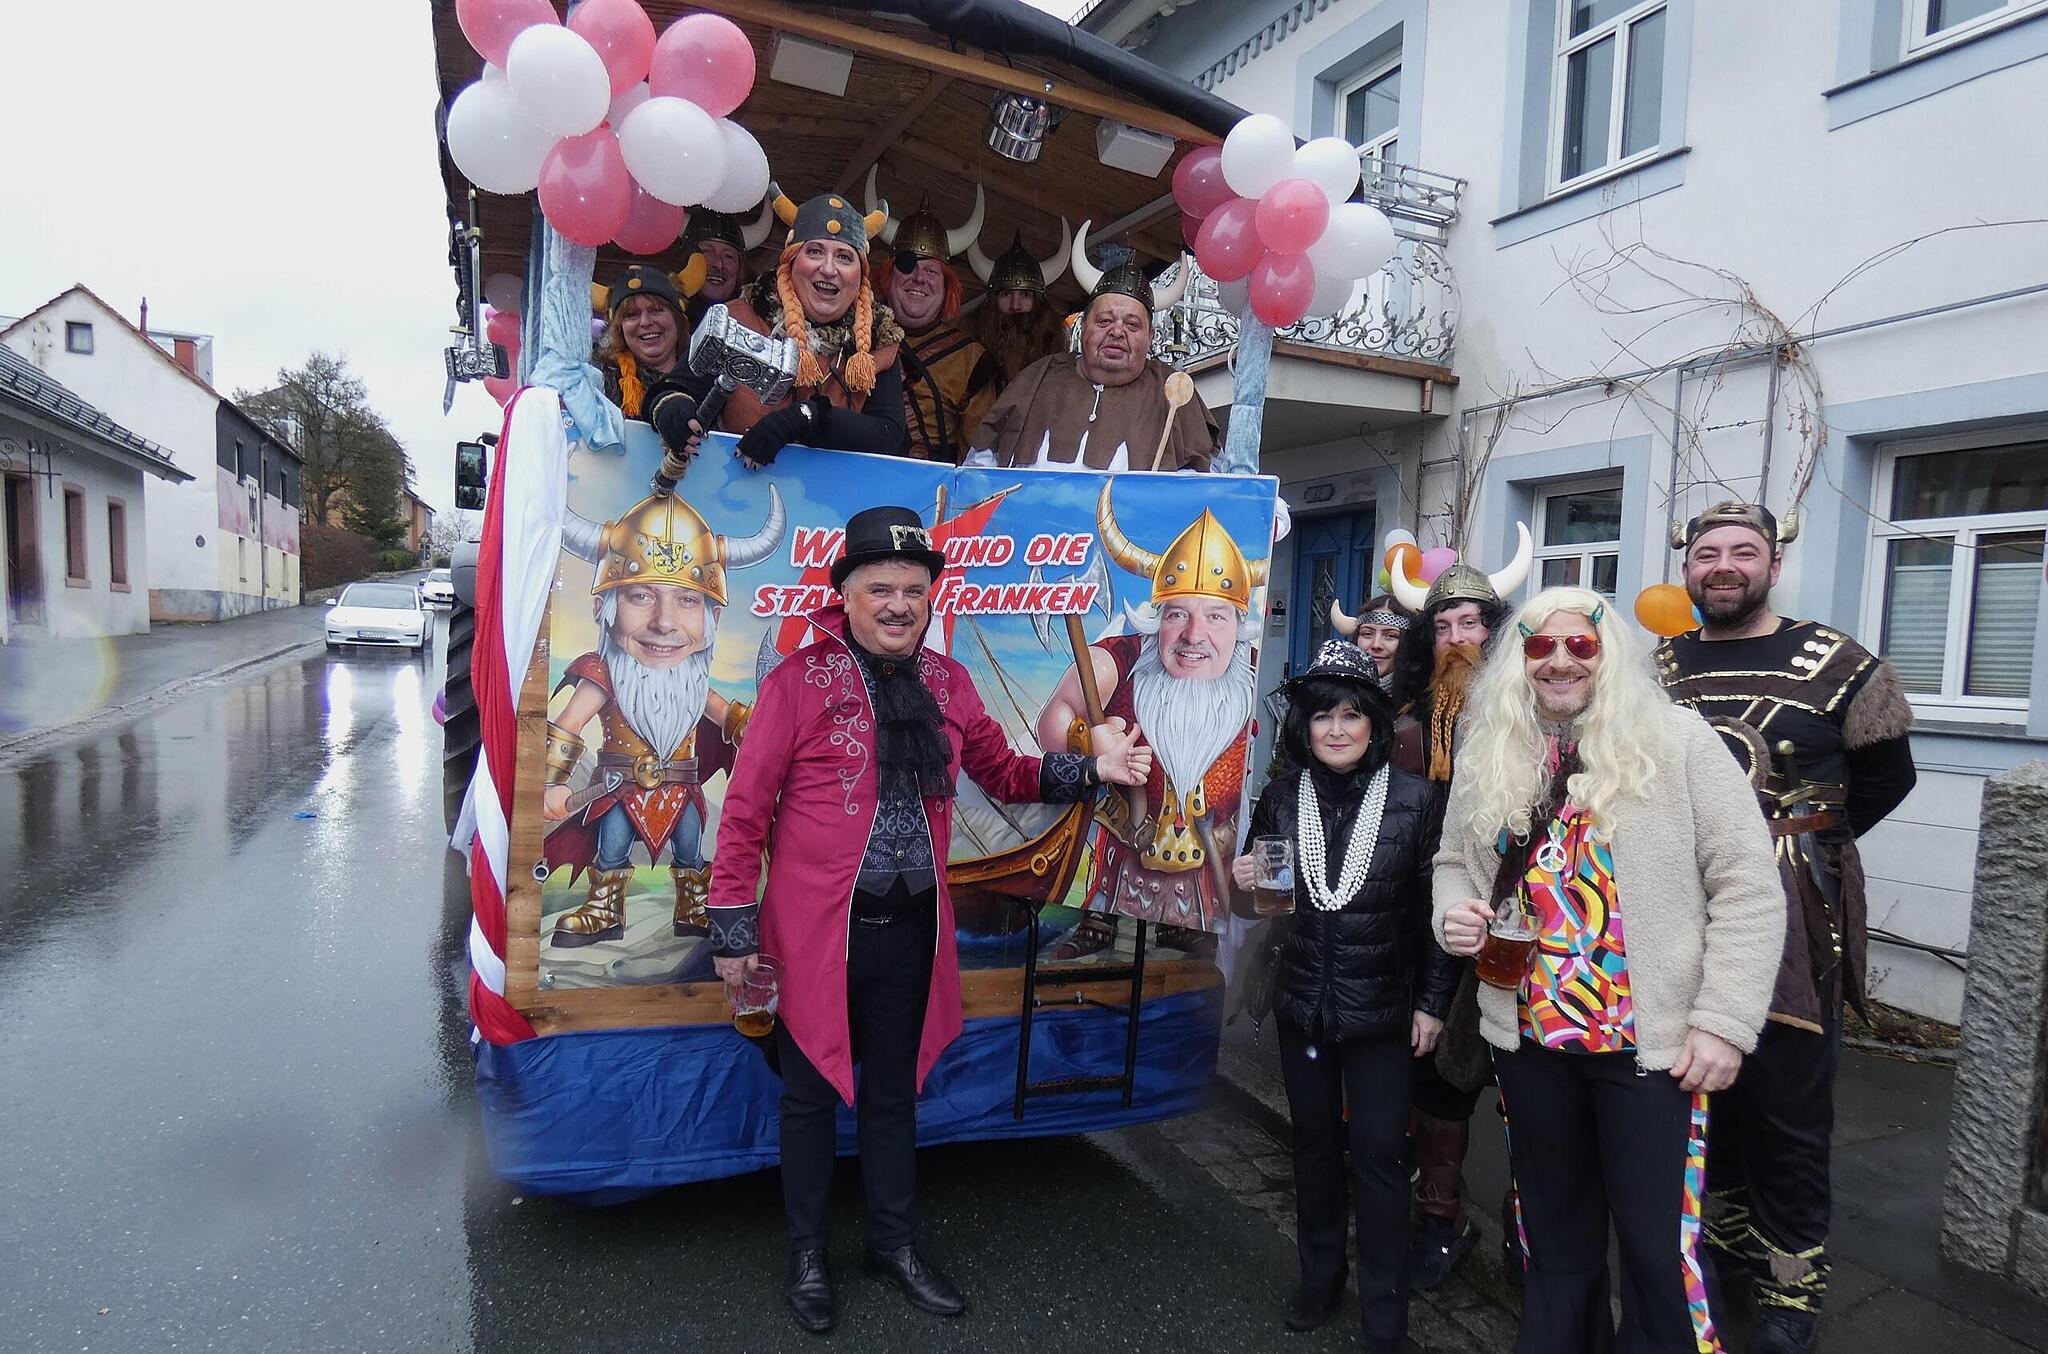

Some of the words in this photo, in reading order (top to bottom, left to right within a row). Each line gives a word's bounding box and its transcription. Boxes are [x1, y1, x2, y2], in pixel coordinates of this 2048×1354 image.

[943, 536, 1014, 567] UND
[1025, 534, 1093, 565] DIE
[933, 576, 1099, 615] FRANKEN
